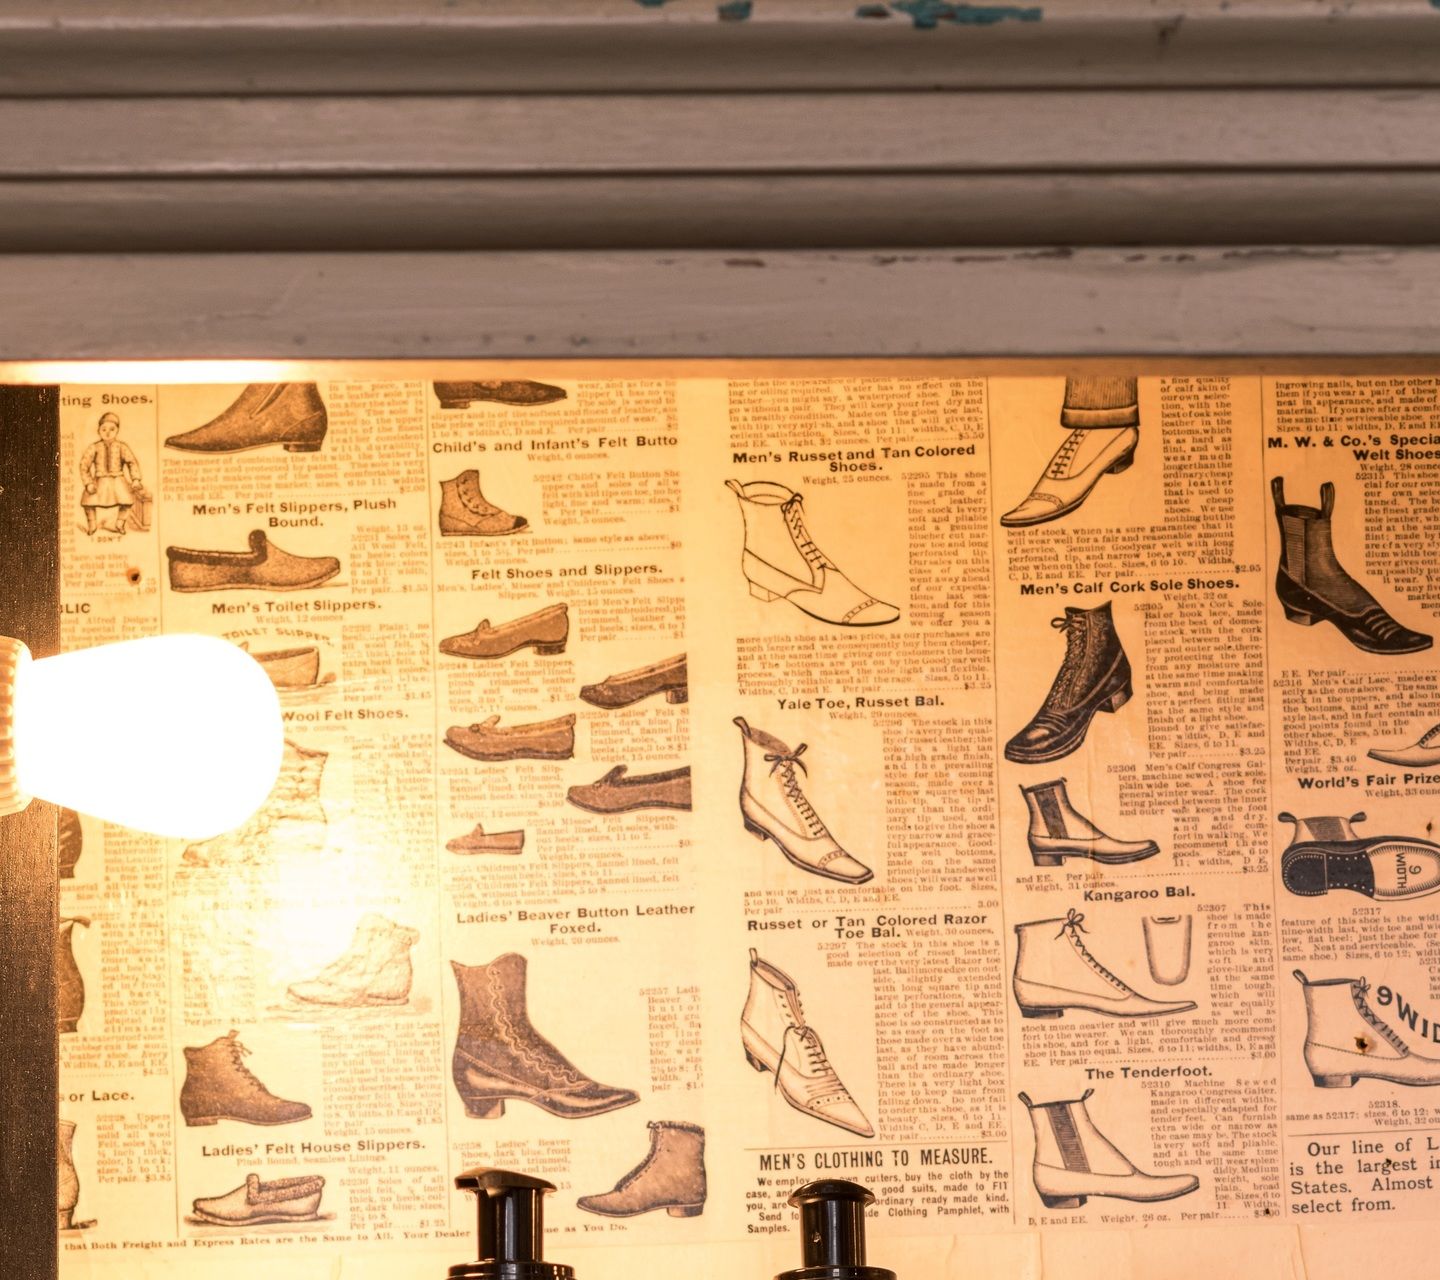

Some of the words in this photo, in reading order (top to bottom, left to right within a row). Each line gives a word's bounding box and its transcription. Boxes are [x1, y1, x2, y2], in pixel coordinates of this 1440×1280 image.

[1267, 436, 1288, 449] M.
[1294, 436, 1317, 448] W.
[1322, 435, 1334, 448] &
[1340, 434, 1382, 447] Co.'s
[732, 451, 782, 464] Men's
[788, 450, 843, 463] Russet
[846, 448, 875, 461] and
[880, 447, 911, 459] Tan
[914, 444, 976, 458] Colored
[1352, 449, 1390, 461] Welt
[829, 461, 883, 473] Shoes.
[1083, 889, 1159, 903] Kangaroo
[1165, 885, 1196, 898] Bal.
[1376, 985, 1393, 1006] 9
[1084, 1068, 1115, 1080] The
[1120, 1065, 1213, 1079] Tenderfoot.
[201, 1143, 259, 1157] Ladies'
[265, 1143, 295, 1155] Felt
[300, 1141, 351, 1154] House
[357, 1139, 426, 1153] Slippers.
[1307, 1141, 1341, 1157] Our
[1352, 1140, 1384, 1155] line
[1394, 1137, 1413, 1153] of
[759, 1153, 806, 1171] MEN'S
[814, 1150, 883, 1169] CLOTHING
[891, 1149, 909, 1167] TO
[920, 1147, 993, 1166] MEASURE.
